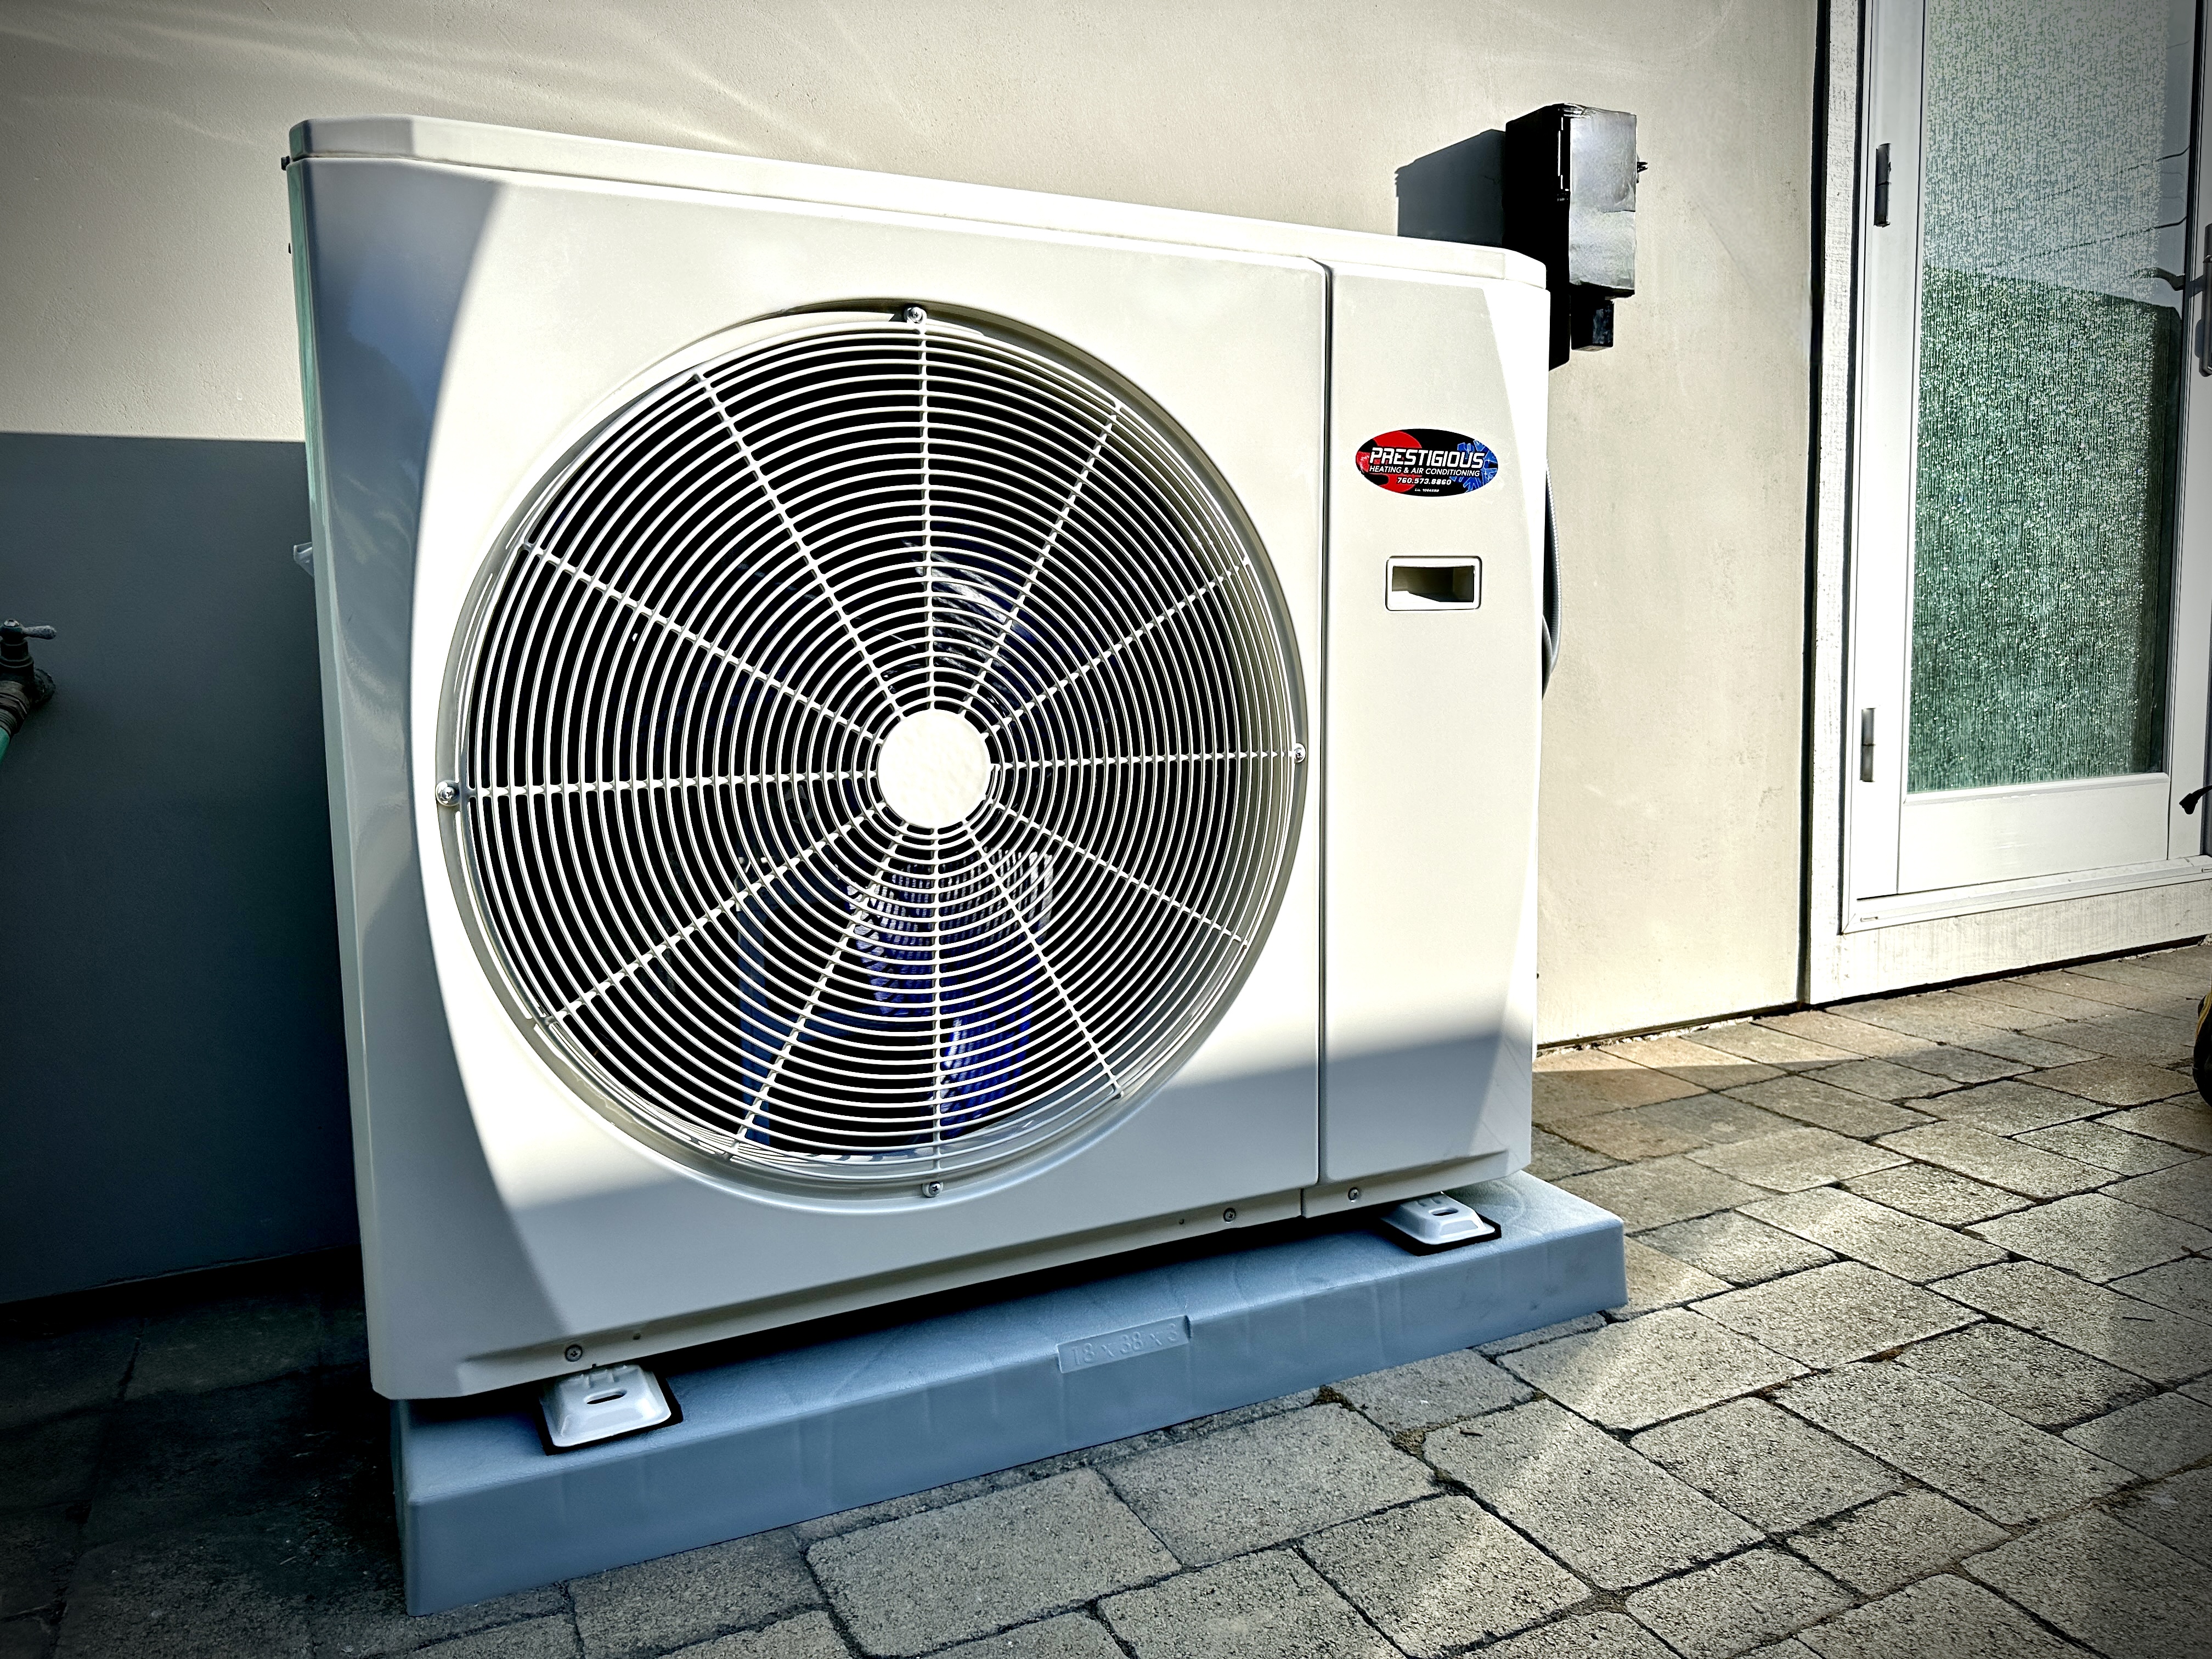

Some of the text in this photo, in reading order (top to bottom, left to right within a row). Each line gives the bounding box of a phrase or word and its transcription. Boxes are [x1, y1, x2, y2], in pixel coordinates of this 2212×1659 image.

[1369, 447, 1485, 469] PRESTIGIOUS
[1369, 465, 1402, 473] HEATING
[1425, 468, 1480, 477] CONDITIONING
[1397, 477, 1452, 485] 760.573.8860
[1071, 1342, 1096, 1365] 18
[1120, 1331, 1145, 1355] 38
[1167, 1322, 1179, 1342] 3
